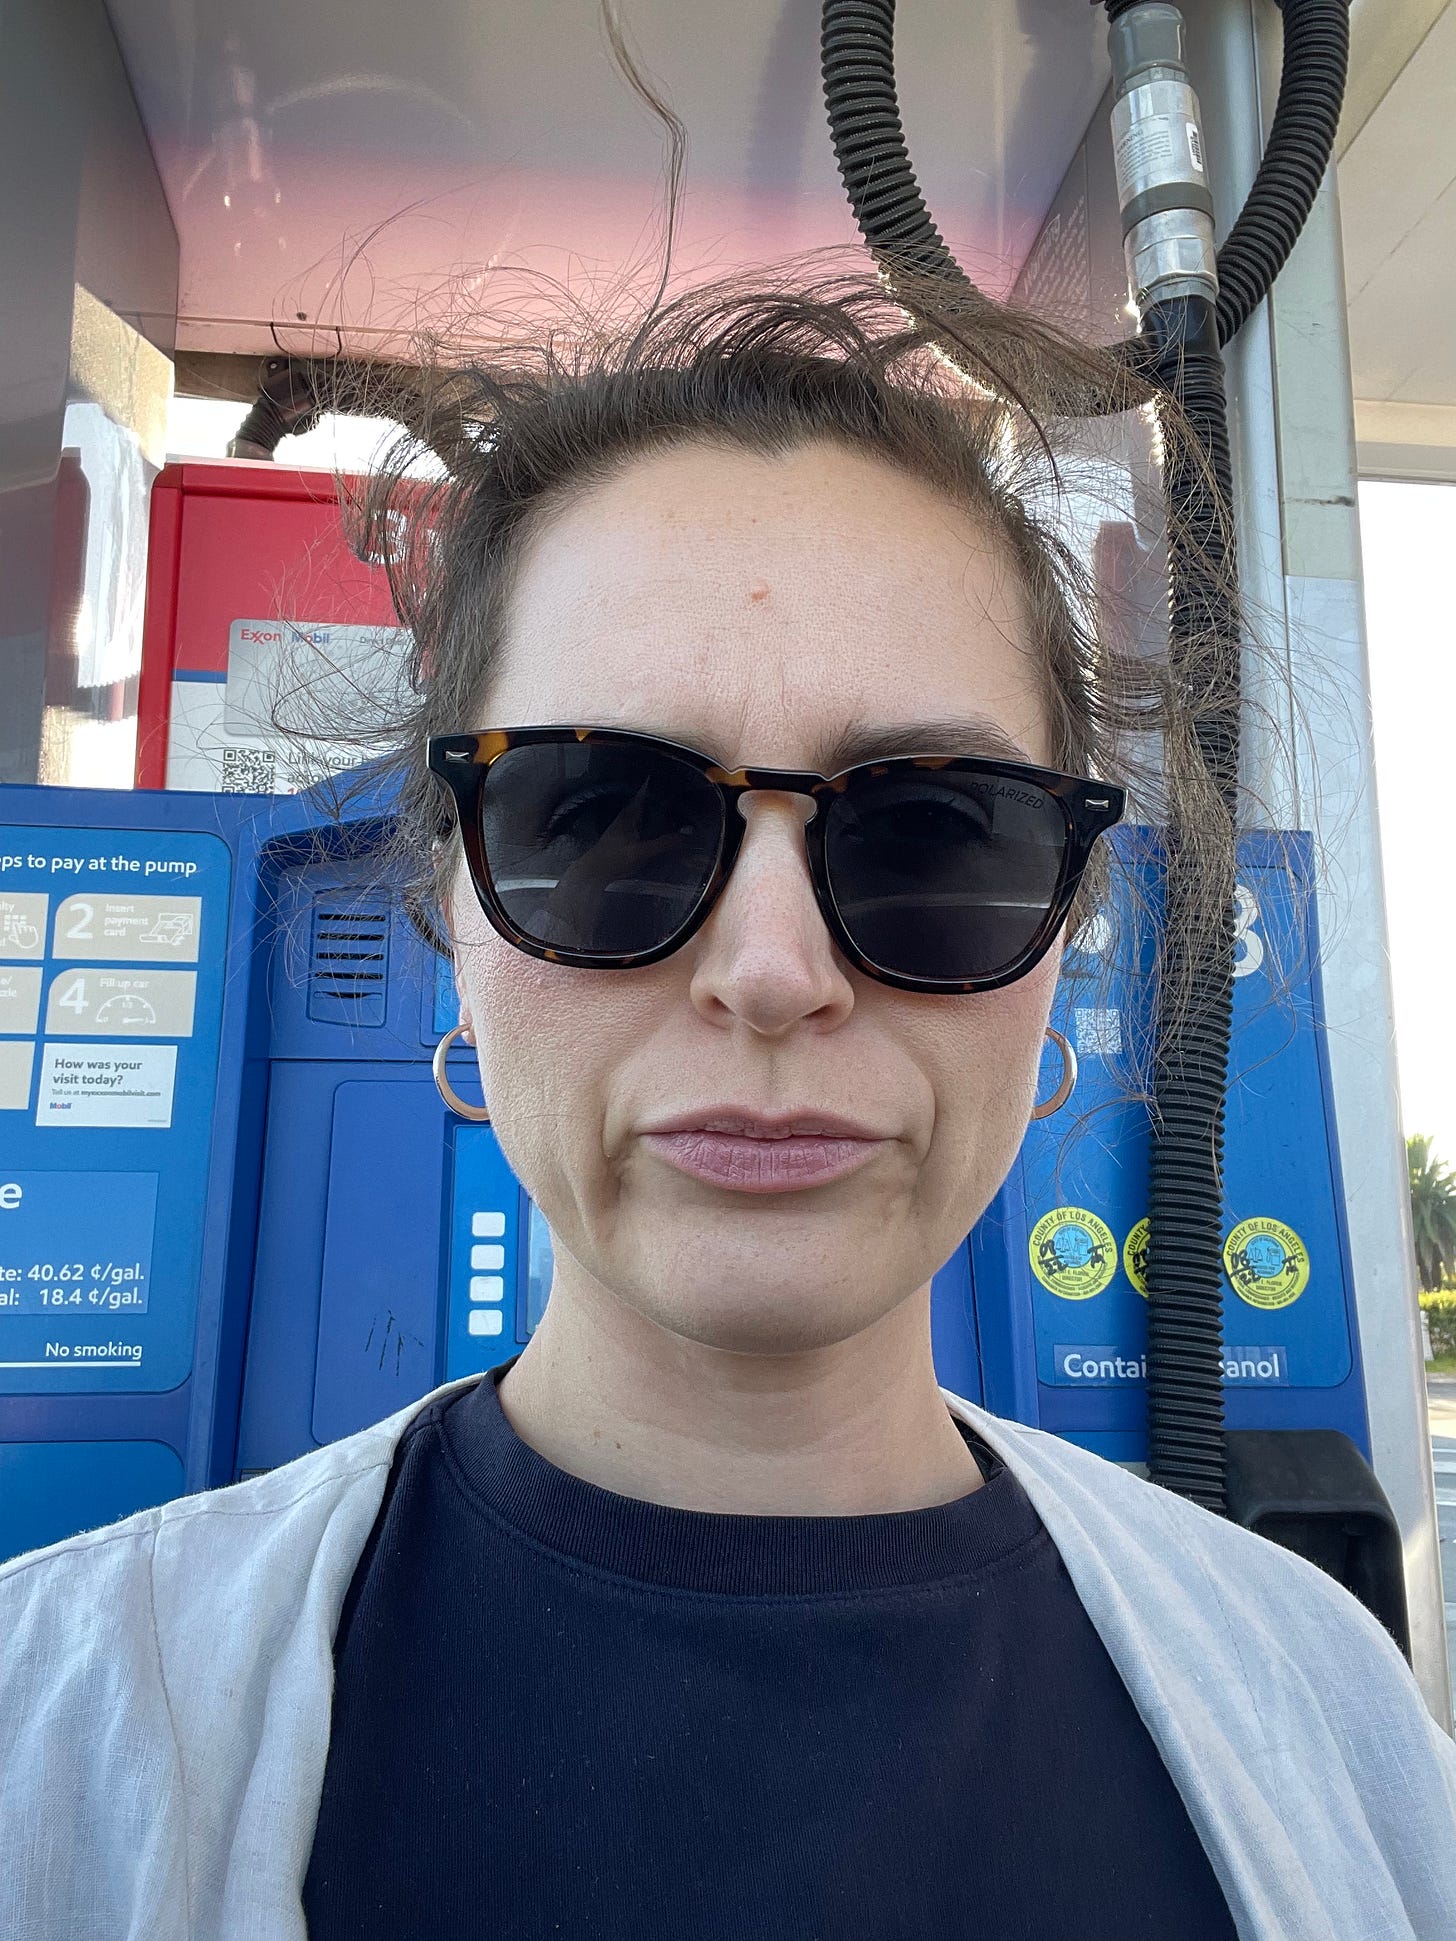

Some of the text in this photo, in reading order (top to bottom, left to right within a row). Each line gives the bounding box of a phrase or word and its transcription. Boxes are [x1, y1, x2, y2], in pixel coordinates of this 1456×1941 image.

[240, 628, 330, 645] Exxon Mobil
[969, 782, 1043, 810] POLARIZED
[0, 854, 197, 878] ps to pay at the pump
[105, 903, 134, 913] Insert
[66, 902, 94, 939] 2
[104, 917, 149, 927] payment
[104, 928, 126, 937] card
[100, 977, 115, 988] Fill
[59, 977, 89, 1015] 4
[54, 1058, 143, 1072] How was your
[52, 1073, 124, 1088] visit today?
[52, 1088, 63, 1096] Tell
[49, 1102, 72, 1110] Mobil
[1033, 1215, 1054, 1247] COUNTY
[1057, 1210, 1067, 1221] OF
[1070, 1210, 1087, 1222] LOS
[1087, 1219, 1113, 1254] ANGELES
[1127, 1223, 1146, 1257] COUNTY
[1226, 1226, 1247, 1257] COUNTY
[1247, 1221, 1258, 1232] OF
[1261, 1221, 1278, 1233] LOS
[1278, 1228, 1305, 1264] ANGELES
[28, 1264, 84, 1281] 40.62
[90, 1262, 145, 1285] ¢/gal.
[39, 1288, 82, 1306] 18.4
[88, 1287, 143, 1309] ¢/gal.
[45, 1341, 143, 1360] No smoking
[1218, 1353, 1280, 1378] anol
